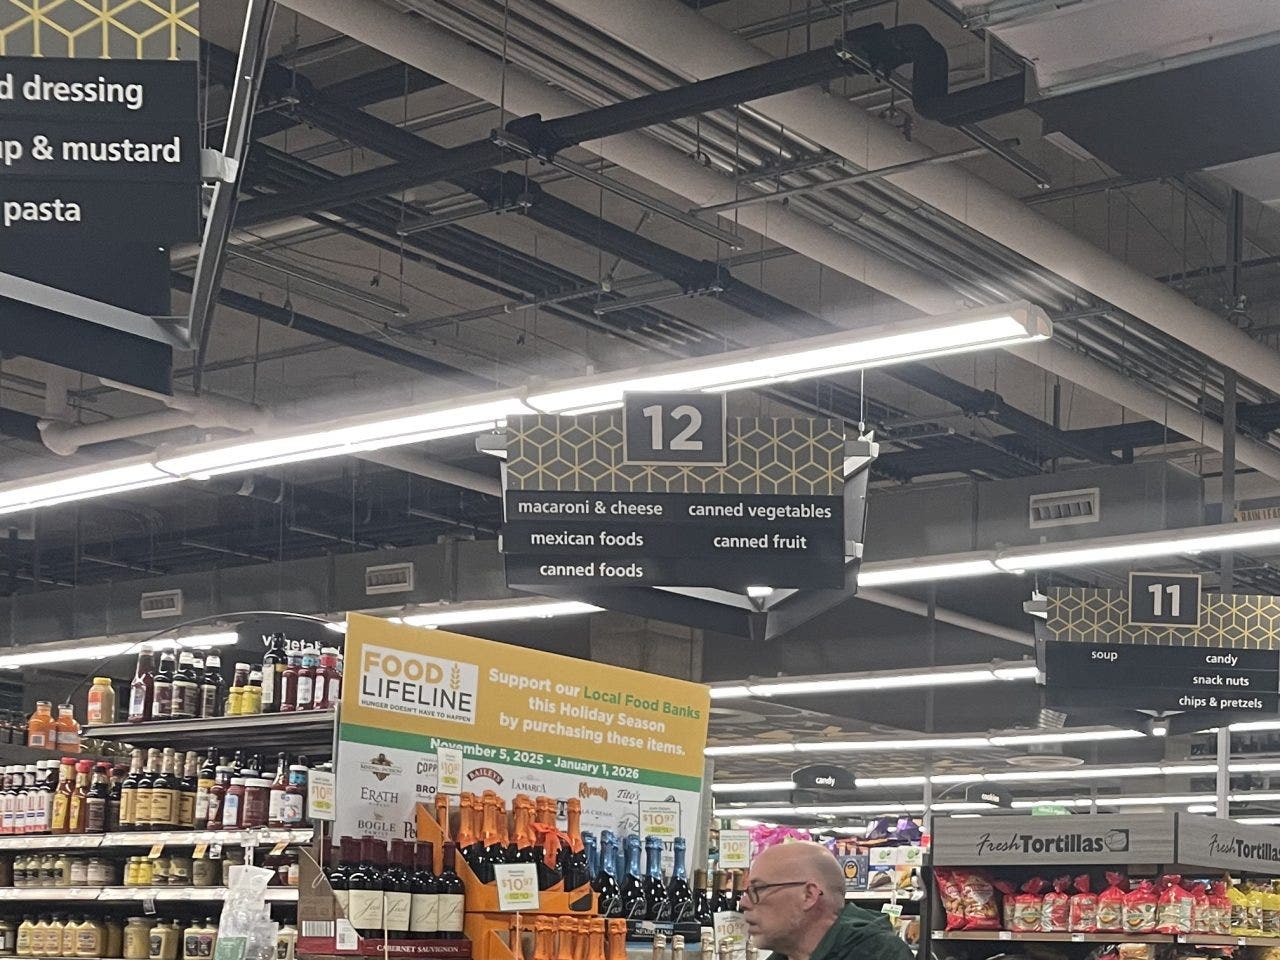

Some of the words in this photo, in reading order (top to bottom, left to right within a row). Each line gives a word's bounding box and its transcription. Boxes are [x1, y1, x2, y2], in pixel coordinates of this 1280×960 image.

[23, 74, 143, 110] dressing
[32, 135, 53, 160] &
[62, 136, 181, 163] mustard
[4, 198, 81, 226] pasta
[643, 405, 703, 451] 12
[518, 500, 589, 515] macaroni
[594, 501, 608, 515] &
[610, 501, 663, 516] cheese
[688, 502, 743, 517] canned
[748, 502, 832, 522] vegetables
[531, 532, 595, 546] mexican
[599, 531, 644, 547] foods
[713, 534, 769, 549] canned
[772, 534, 807, 549] fruit
[540, 562, 594, 577] canned
[599, 562, 643, 577] foods
[1148, 584, 1180, 617] 11
[1091, 650, 1118, 662] soup
[1206, 653, 1238, 667] candy
[364, 652, 444, 684] FOOD
[1193, 676, 1223, 686] snack
[1227, 676, 1249, 687] nuts
[363, 675, 472, 712] LIFELINE
[489, 668, 551, 692] Support
[555, 684, 580, 697] our
[584, 686, 620, 705] Local
[625, 695, 659, 711] Food
[663, 701, 700, 720] Banks
[1179, 696, 1207, 708] chips
[1209, 697, 1217, 707] &
[1220, 697, 1263, 711] pretzels
[362, 700, 388, 709] HUNGER
[390, 704, 417, 713] DOESN'T
[419, 709, 435, 717] HAVE
[446, 713, 470, 722] HAPPEN
[529, 697, 555, 713] this
[560, 703, 613, 725] Holiday
[618, 713, 665, 733] Season
[499, 712, 519, 730] by
[523, 718, 603, 744] purchasing
[607, 730, 643, 748] these
[647, 737, 686, 756] items.
[500, 748, 510, 762] 5,
[513, 751, 544, 765] 2025
[554, 757, 599, 775] January
[612, 766, 640, 779] 2026
[469, 768, 503, 784] BAILEYS
[816, 776, 835, 787] candy
[361, 786, 399, 804] ERATH
[416, 784, 437, 794] BRO
[358, 820, 396, 832] BOGLE
[976, 832, 1022, 857] Fresh
[1020, 835, 1104, 854] Tortillas
[1208, 834, 1237, 856] Fresh
[417, 945, 459, 953] SAUVIGNON
